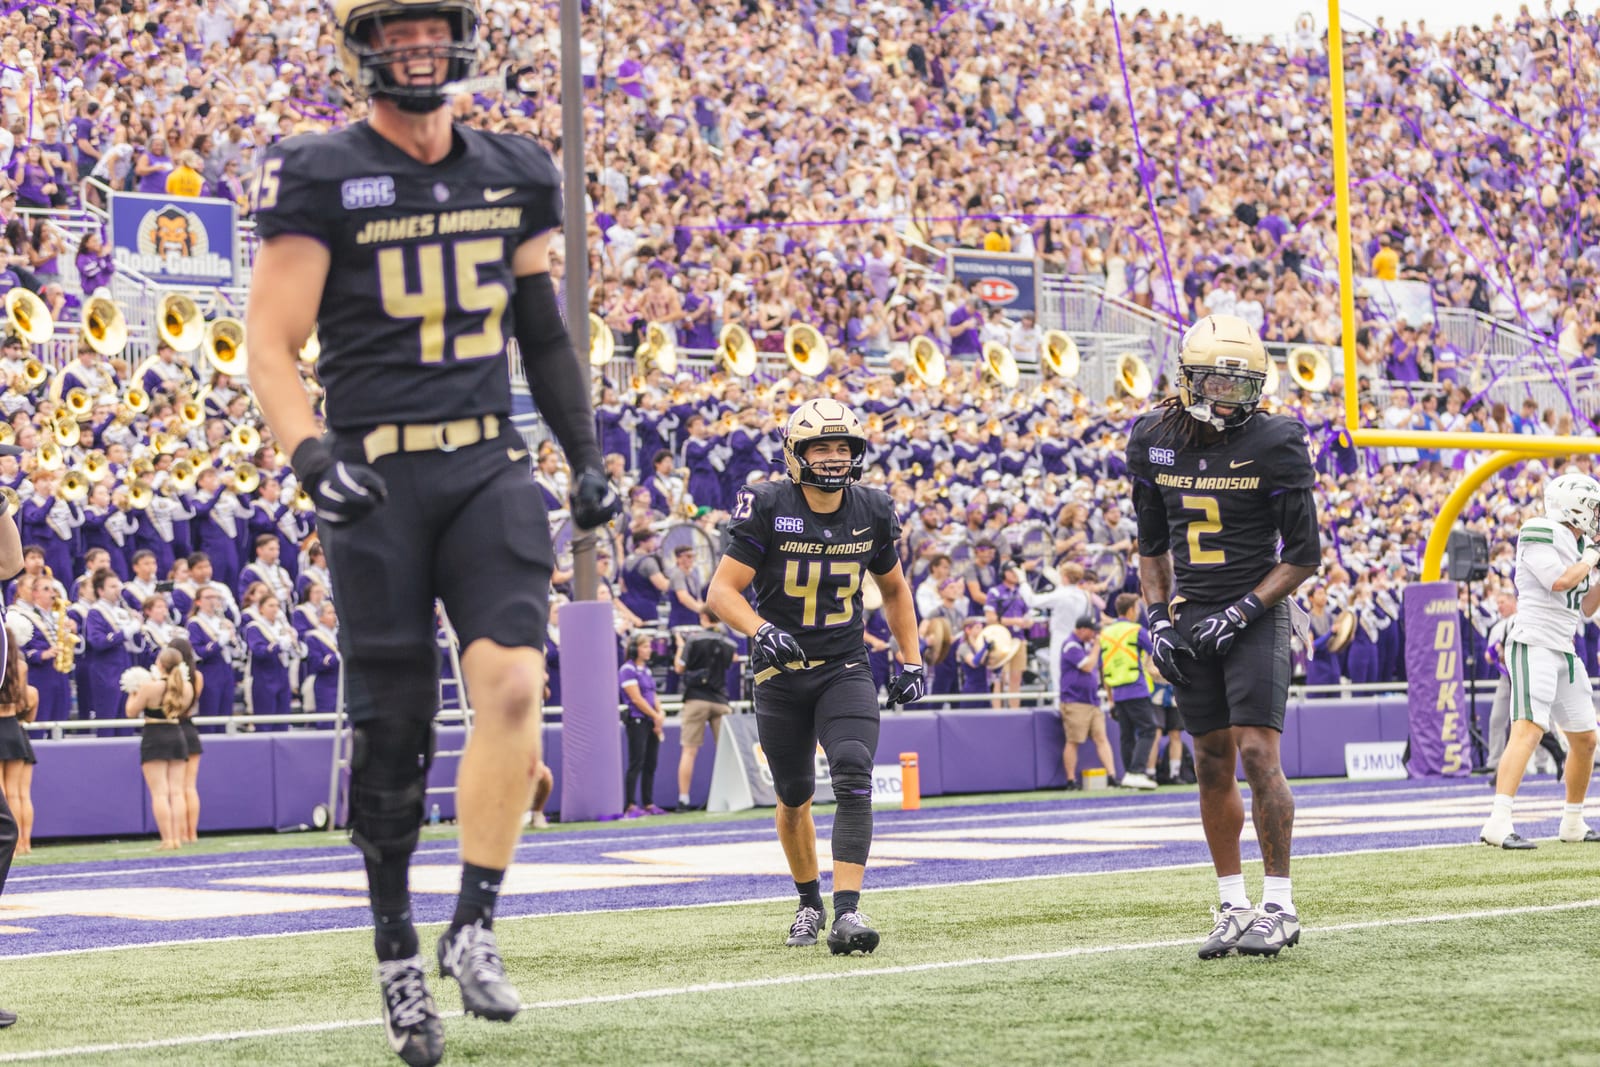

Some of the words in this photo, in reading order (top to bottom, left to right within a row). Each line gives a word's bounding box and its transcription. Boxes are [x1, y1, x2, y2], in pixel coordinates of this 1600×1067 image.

[357, 213, 434, 244] JAMES
[439, 207, 523, 234] MADISON
[377, 236, 508, 363] 45
[823, 425, 847, 433] DUKES
[1149, 447, 1175, 467] SBC
[1155, 473, 1193, 489] JAMES
[1195, 477, 1260, 490] MADISON
[774, 516, 804, 534] SBC
[1181, 495, 1226, 565] 2
[780, 540, 823, 553] JAMES
[825, 540, 874, 555] MADISON
[783, 560, 862, 627] 43
[1434, 620, 1462, 775] DUKES
